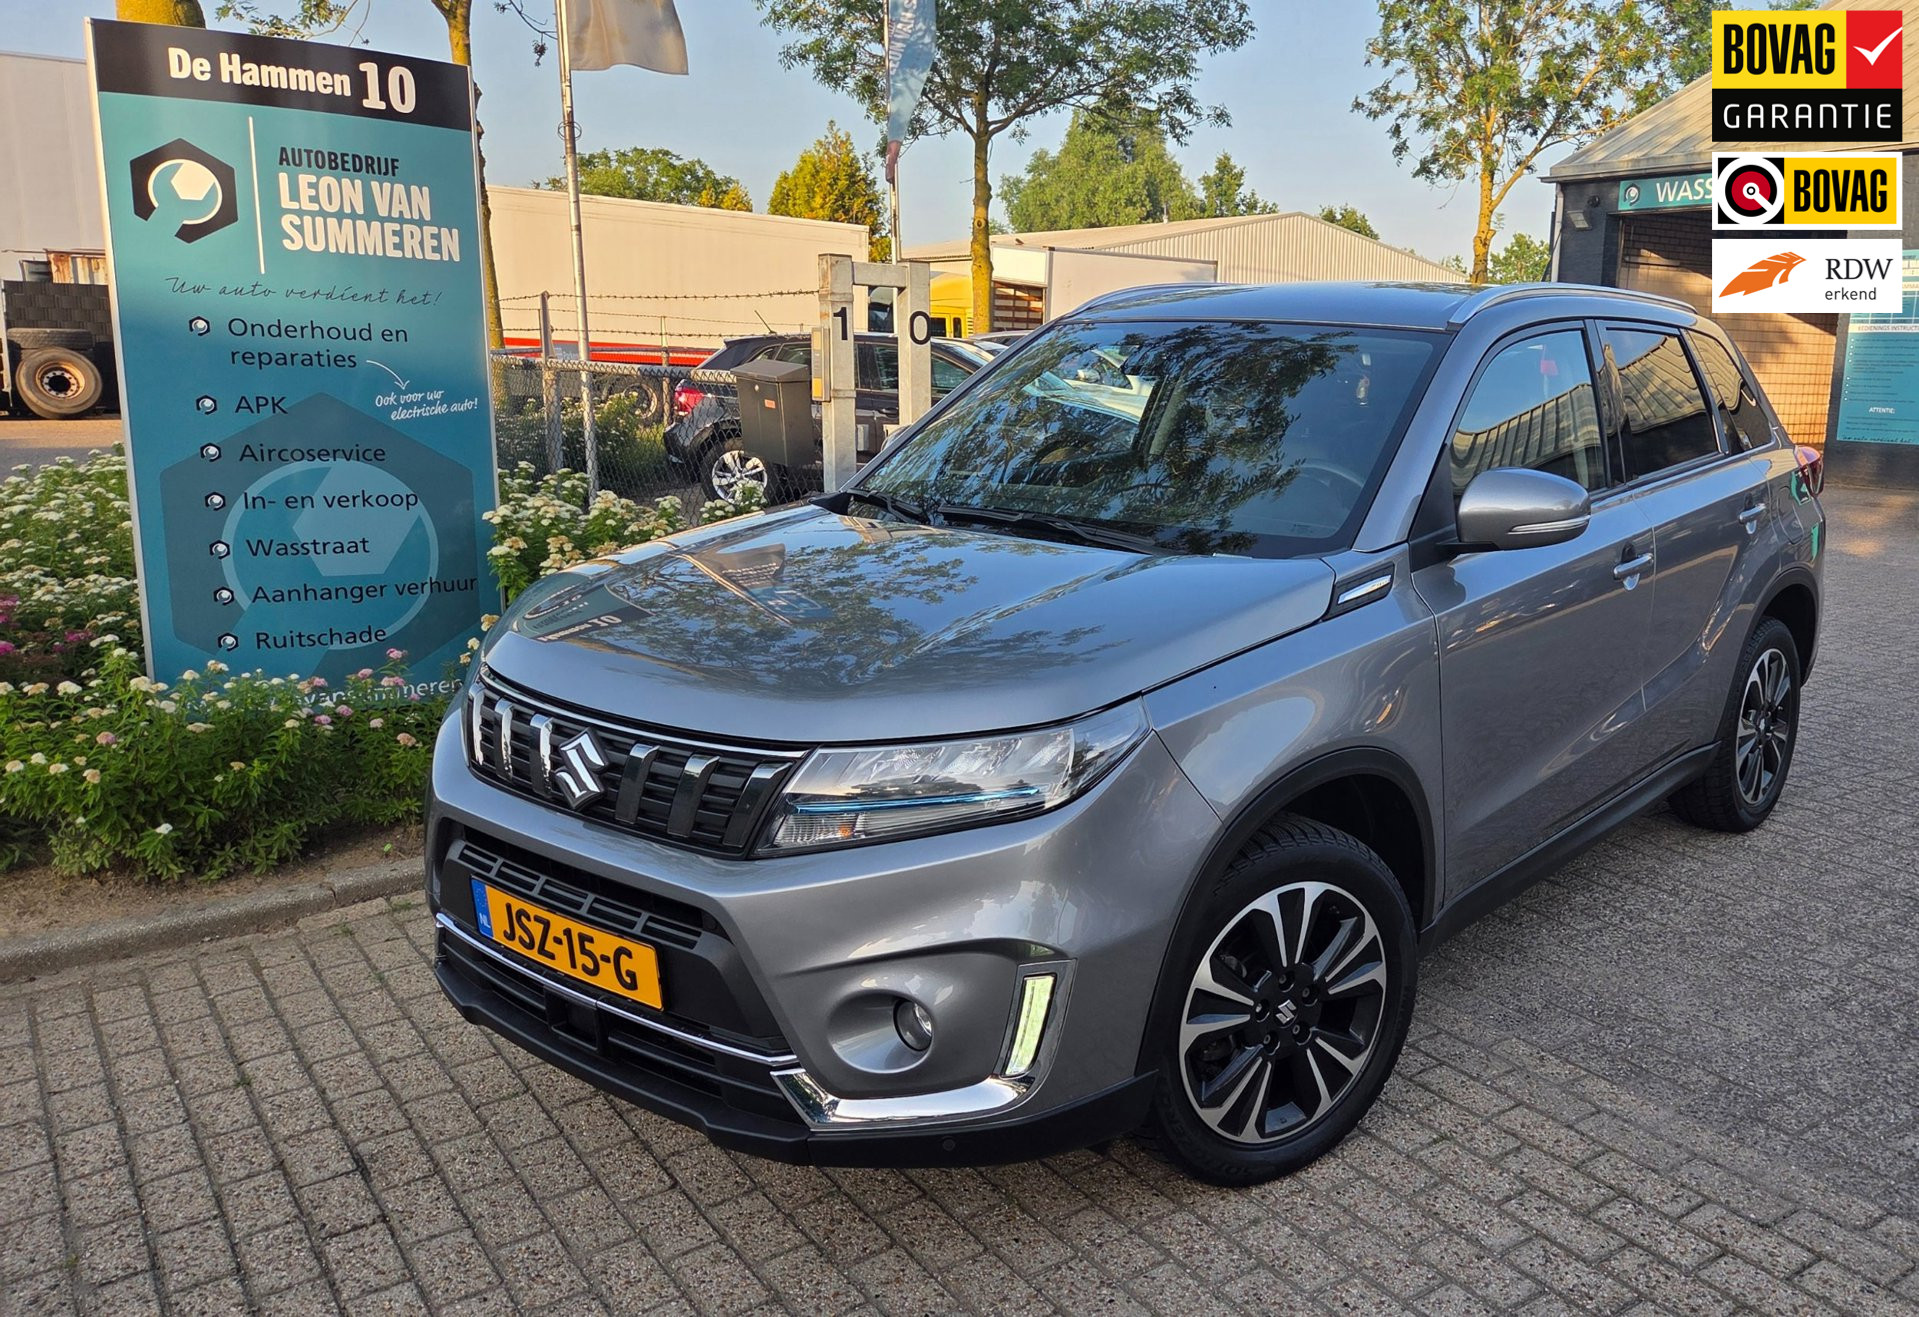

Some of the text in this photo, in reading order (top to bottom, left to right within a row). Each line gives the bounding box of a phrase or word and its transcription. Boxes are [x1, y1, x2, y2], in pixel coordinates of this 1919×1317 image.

[168, 47, 417, 114] De Hammen 10
[279, 147, 400, 178] AUTOBEDRIJF
[278, 172, 432, 222] LEON VAN
[281, 214, 461, 263] SUMMEREN
[166, 276, 444, 307] Uw auto verdient het!
[228, 318, 408, 343] Onderhoud en
[833, 307, 848, 340] 1
[230, 348, 358, 370] reparaties
[235, 396, 288, 414] APK
[375, 390, 445, 407] Ook voor uw
[391, 397, 478, 420] electrische auto!
[239, 444, 386, 463] Aircoservice
[243, 489, 419, 512] In- en verkoop
[246, 537, 370, 558] Wasstraat
[251, 576, 478, 604] Aanhanger verhuur
[256, 627, 386, 650] Ruitschade
[503, 902, 639, 991] JSZ-15-G
